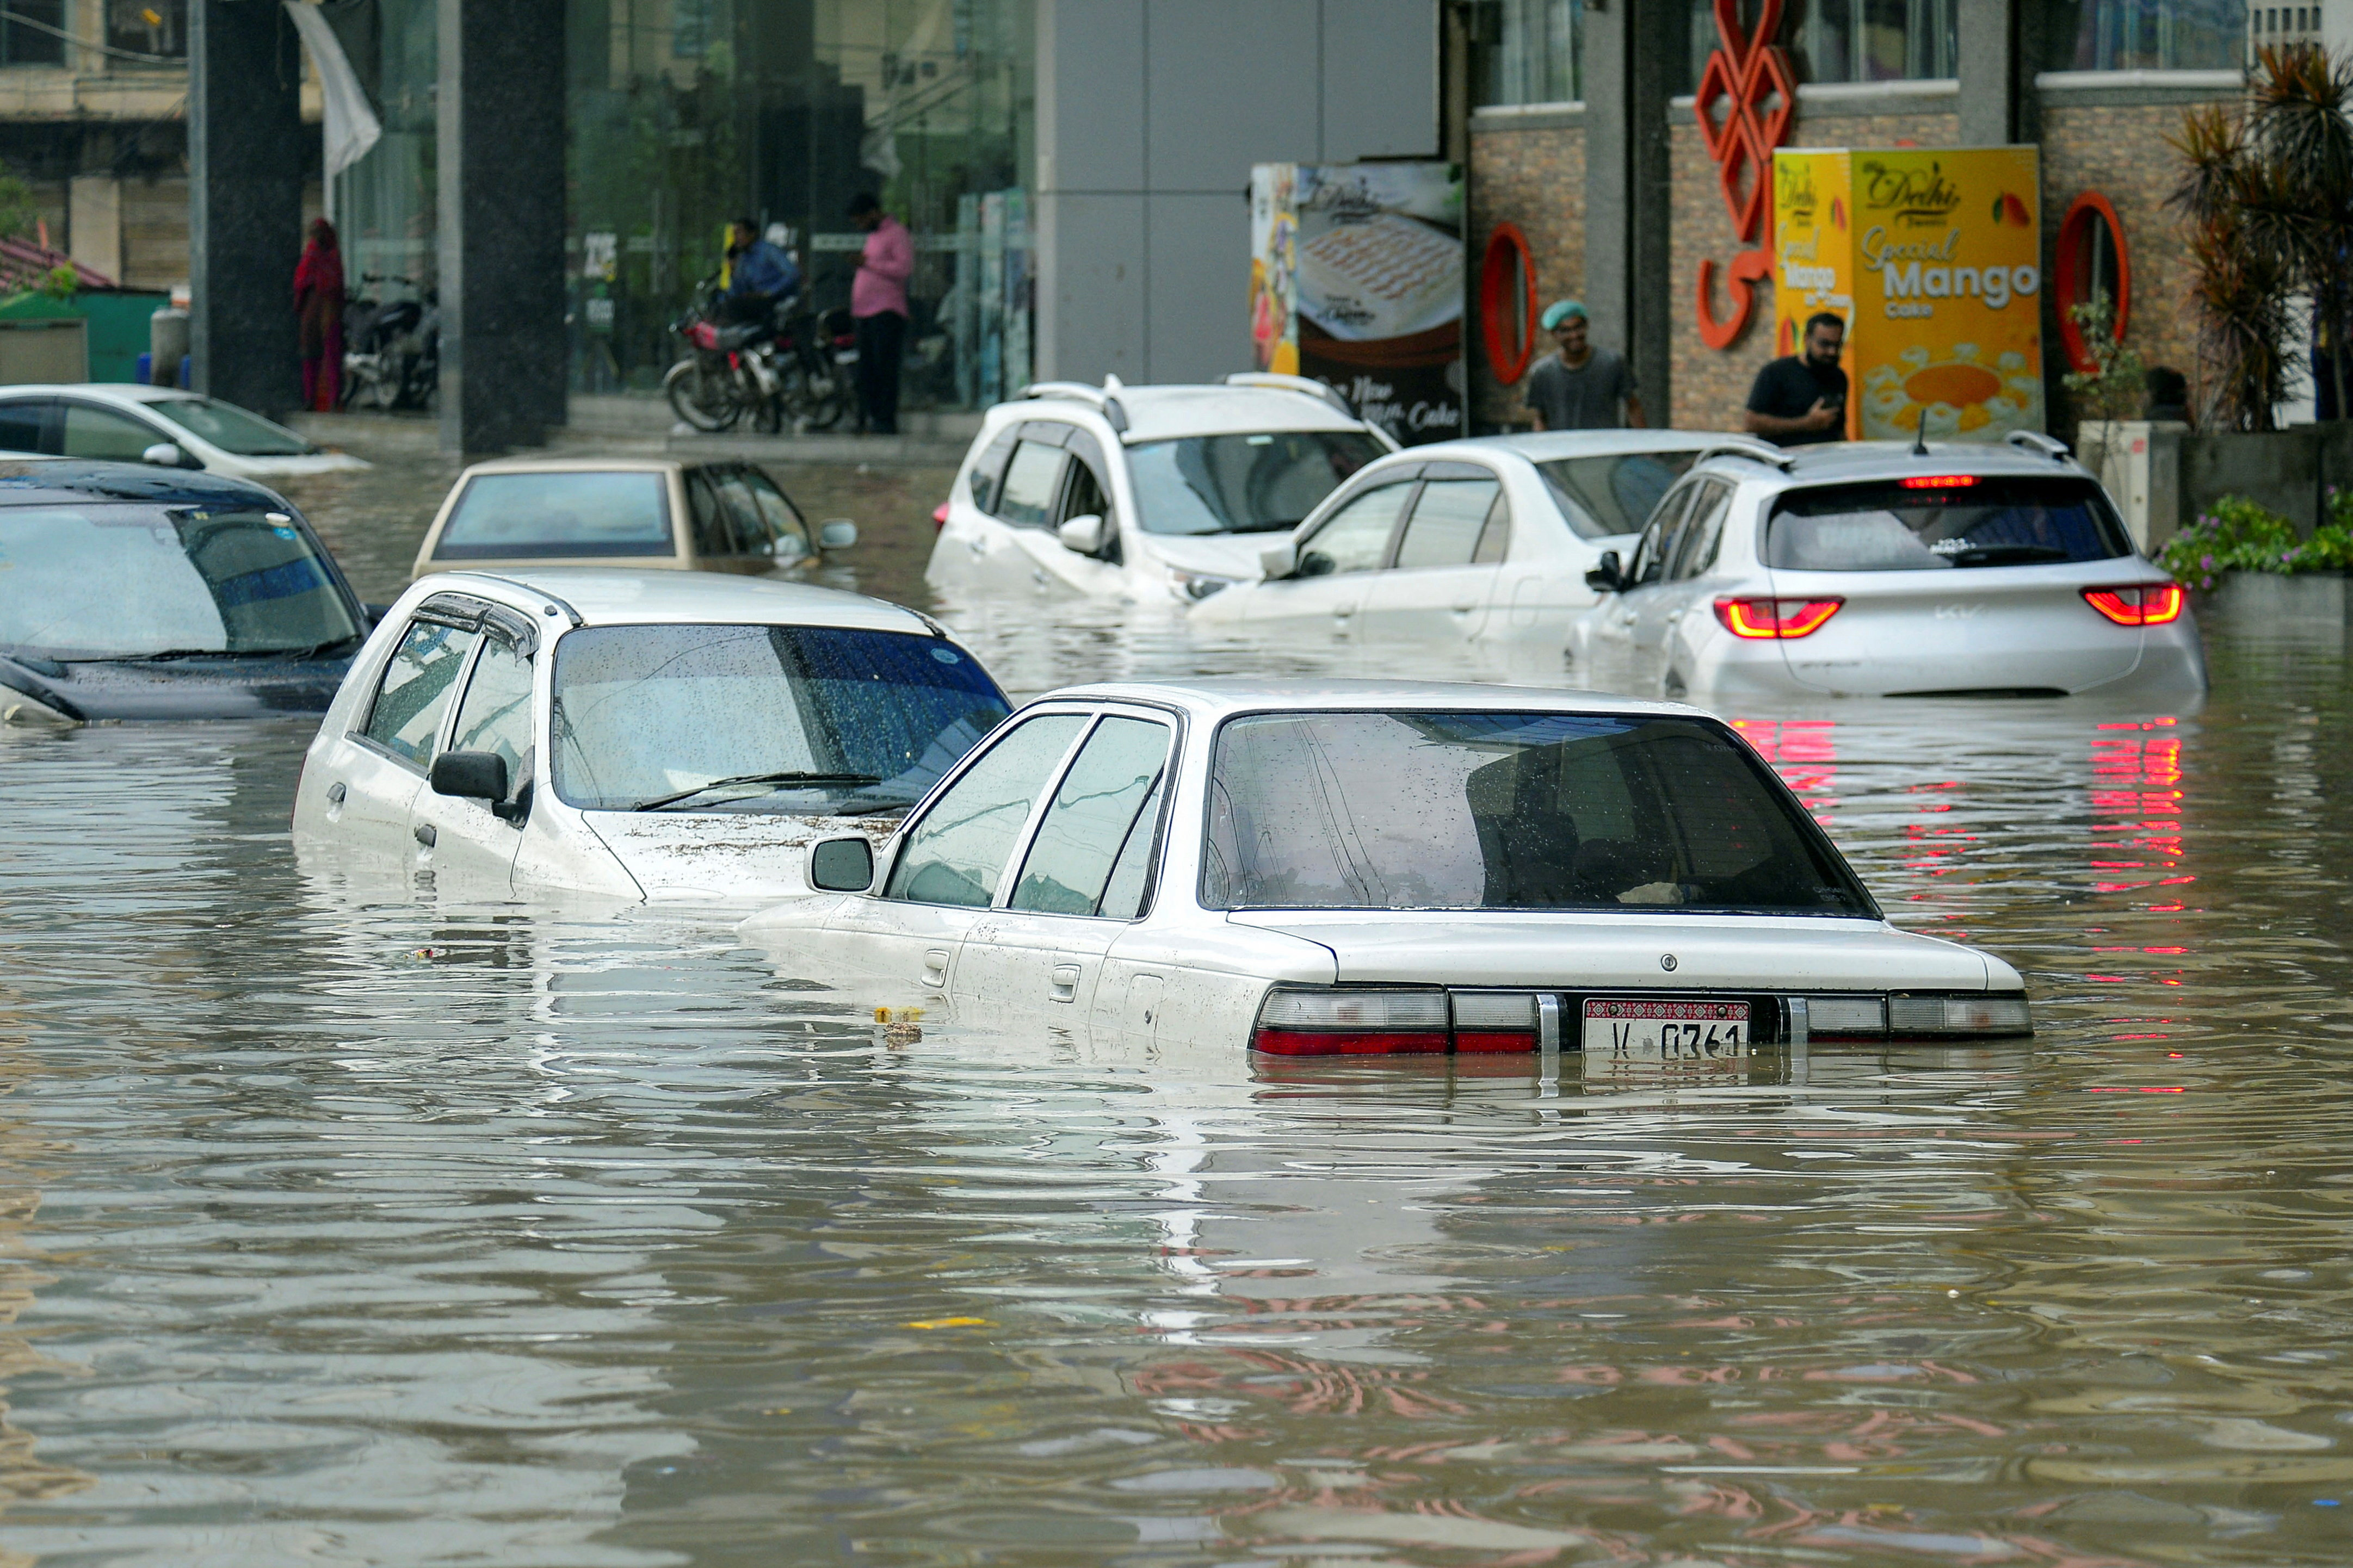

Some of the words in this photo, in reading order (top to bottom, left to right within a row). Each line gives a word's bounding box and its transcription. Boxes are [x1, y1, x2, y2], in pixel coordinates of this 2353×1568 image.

[1861, 225, 1960, 271] Special
[1883, 261, 2040, 309] Mango
[1885, 301, 1933, 319] Cake
